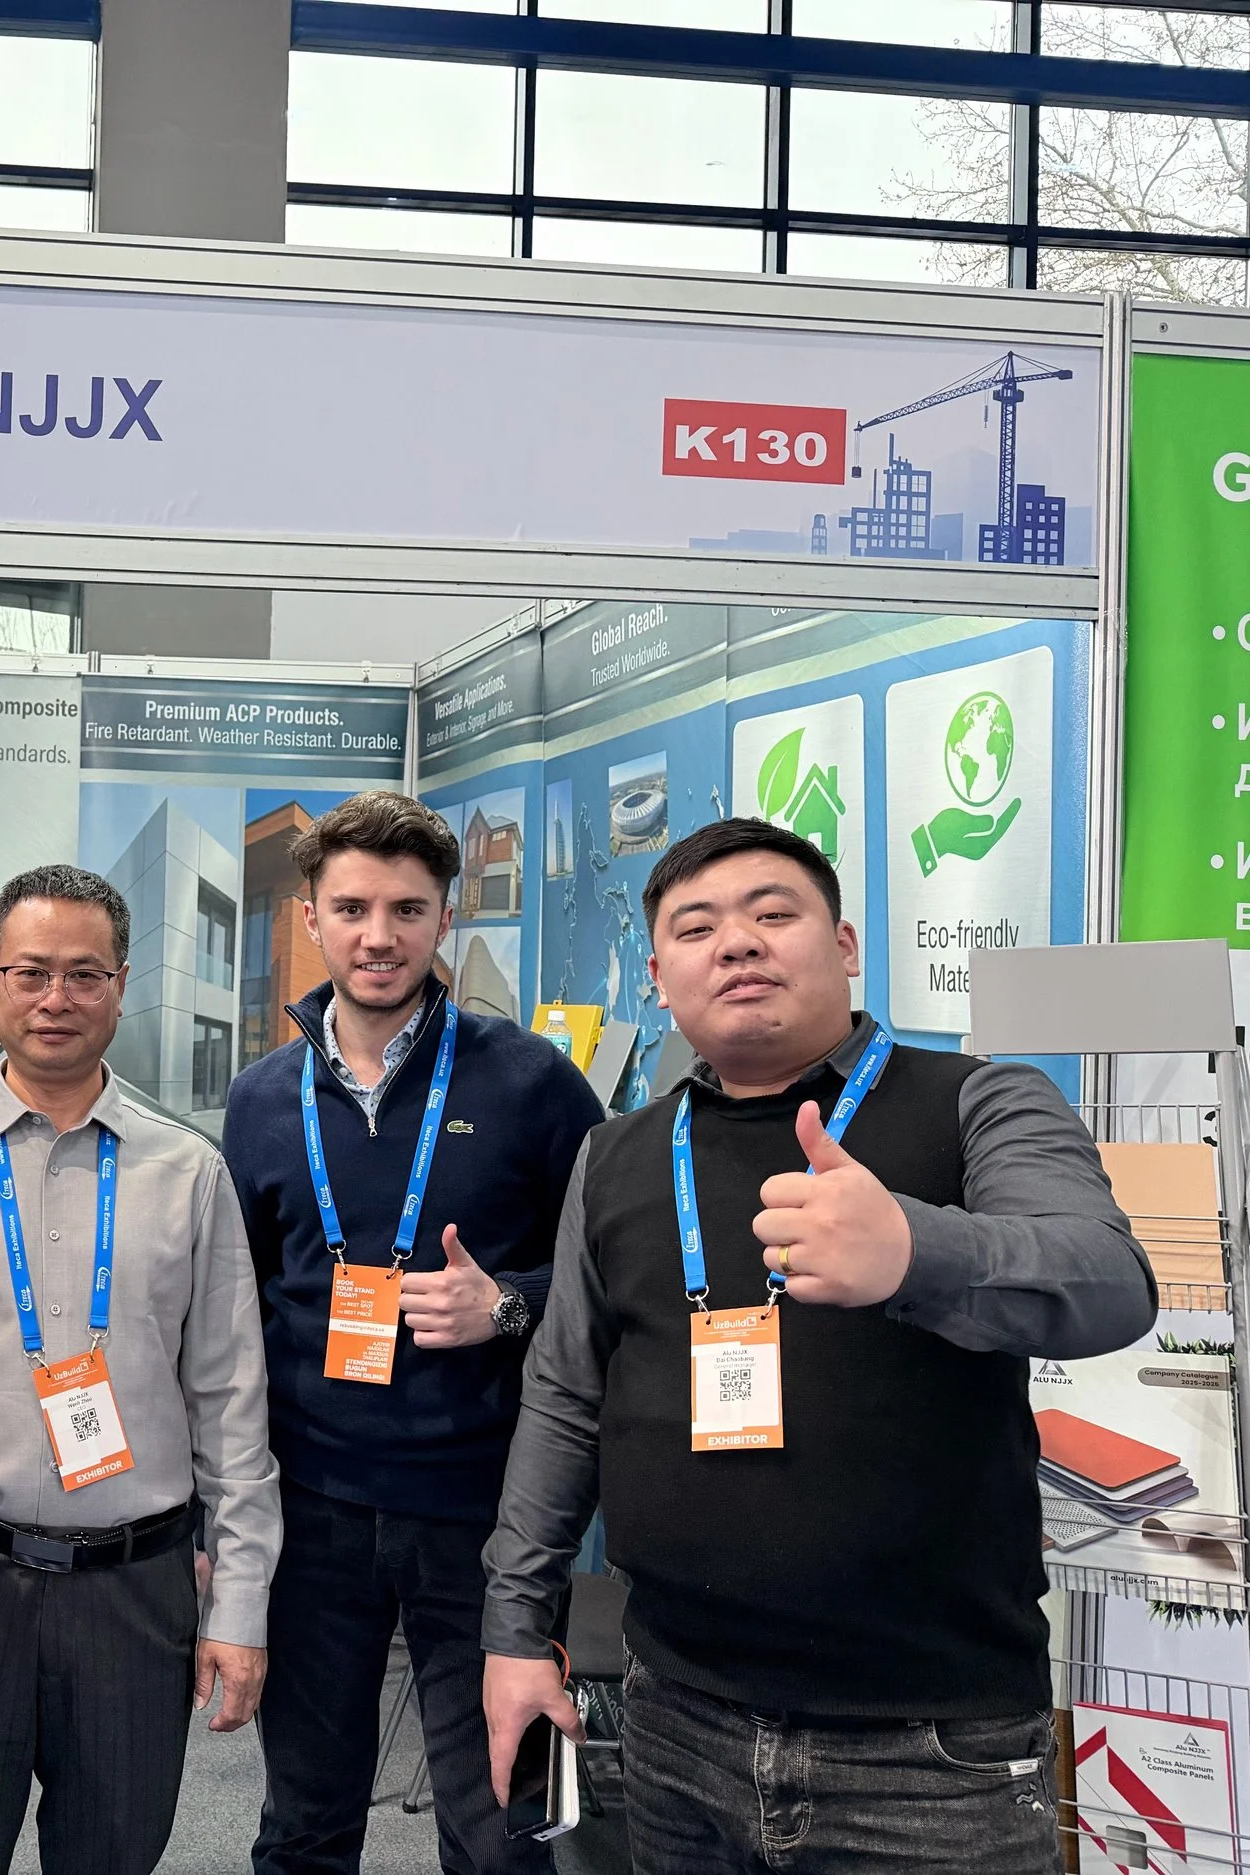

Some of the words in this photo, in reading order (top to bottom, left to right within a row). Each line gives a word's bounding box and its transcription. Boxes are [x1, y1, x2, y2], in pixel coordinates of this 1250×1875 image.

[675, 425, 828, 467] K130
[591, 618, 625, 656] Global
[628, 603, 668, 638] Reach.
[591, 657, 620, 687] Trusted
[621, 638, 670, 674] Worldwide.
[145, 700, 221, 722] Premium
[226, 703, 261, 723] ACP
[265, 705, 344, 726] Products.
[435, 693, 463, 720] Versatile
[85, 722, 113, 739] Fire
[117, 724, 193, 743] Retardant.
[198, 727, 261, 746] Weather
[264, 730, 336, 748] Resistant.
[341, 733, 402, 751] Durable.
[415, 1142, 430, 1178] Exhibitions
[680, 1158, 688, 1194] Exhibitions
[10, 1214, 20, 1252] Exhibitions
[102, 1212, 110, 1250] Exhibitions
[713, 1318, 747, 1330] UzBuild
[54, 1365, 81, 1380] UzBuild
[1051, 1377, 1073, 1385] NJJX
[1144, 1370, 1180, 1378] Company
[1180, 1372, 1219, 1380] Catalogue
[707, 1435, 768, 1446] EXHIBITOR
[76, 1460, 123, 1483] EXHIBITOR
[1147, 1764, 1188, 1776] Composite
[1190, 1771, 1215, 1780] Panels
[1153, 1757, 1172, 1766] Class
[1174, 1761, 1214, 1773] Aluminum
